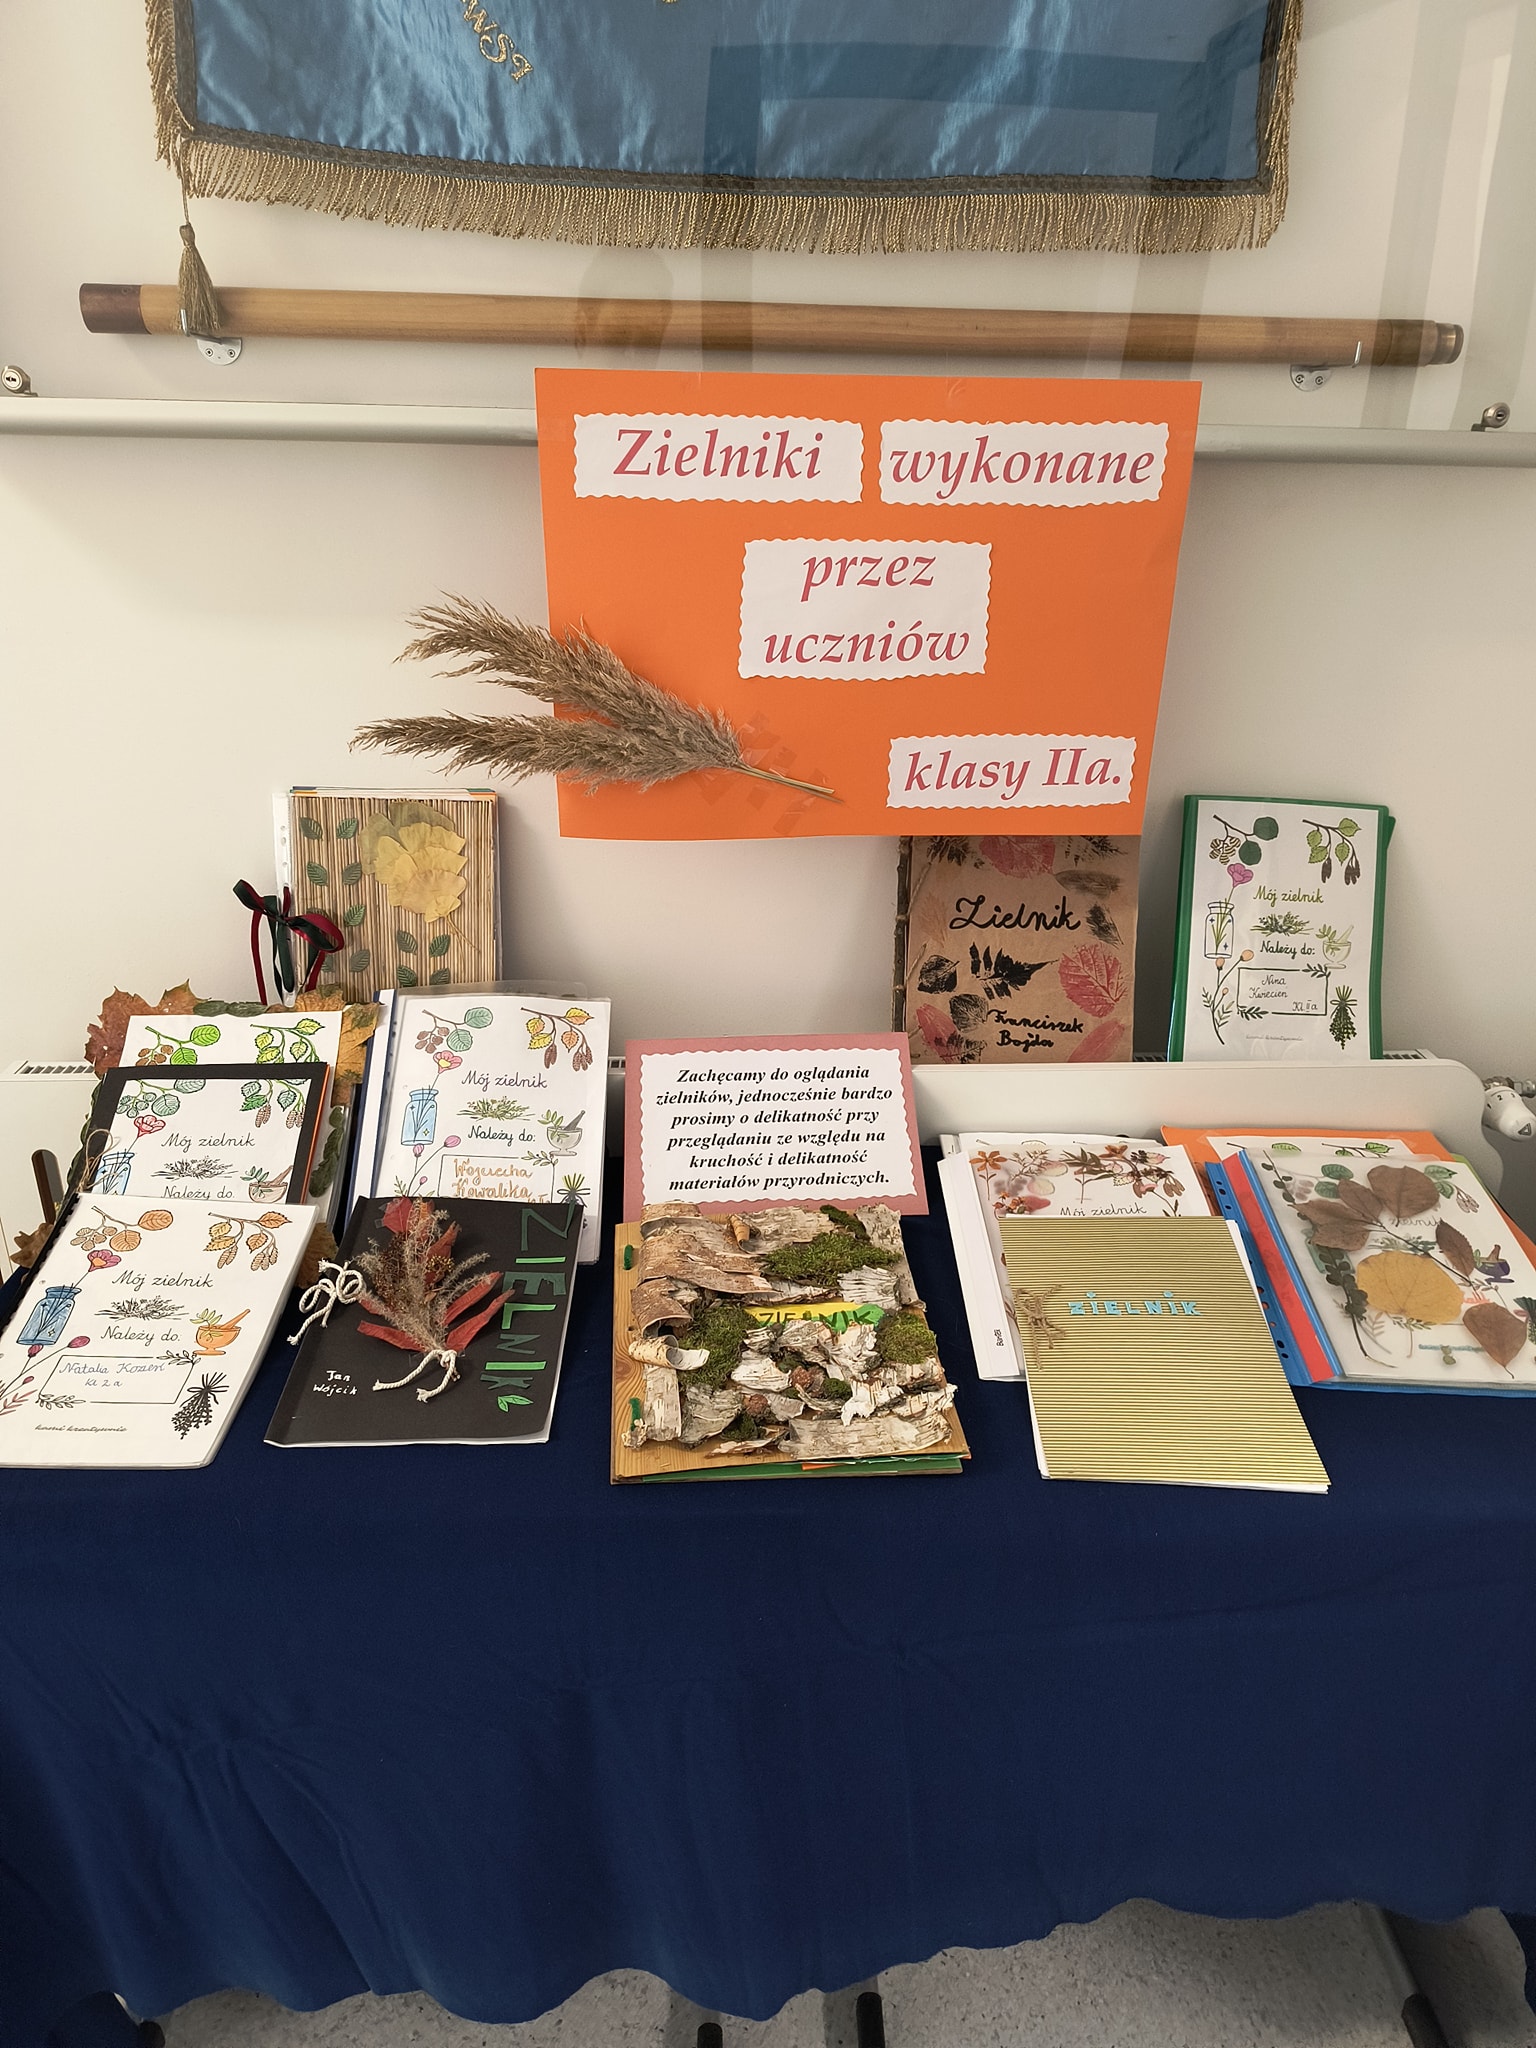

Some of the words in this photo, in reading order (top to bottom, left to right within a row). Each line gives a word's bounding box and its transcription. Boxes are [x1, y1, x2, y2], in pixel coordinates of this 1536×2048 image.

[613, 428, 824, 478] Zielniki
[890, 436, 1155, 500] wykonane
[801, 554, 937, 602] przez
[764, 620, 970, 664] uczniów
[904, 752, 1030, 800] klasy
[1041, 748, 1122, 787] IIa.
[1253, 886, 1276, 907] Mój
[1281, 889, 1324, 904] zielnik
[949, 895, 1081, 931] Zielnik
[1260, 940, 1297, 960] Należy
[1300, 942, 1316, 955] do:
[987, 1009, 1083, 1033] Franciszek
[997, 1030, 1054, 1053] Bojda
[461, 1071, 490, 1092] Mój
[494, 1073, 548, 1088] zielnik
[677, 1069, 766, 1084] Zachęcamy
[770, 1068, 788, 1081] do
[794, 1066, 870, 1083] oglądania
[656, 1091, 733, 1105] zielników,
[736, 1088, 836, 1106] jednocześnie
[842, 1087, 893, 1100] bardzo
[671, 1113, 735, 1129] prosimy
[740, 1114, 749, 1124] o
[754, 1108, 842, 1124] delikatność
[846, 1109, 880, 1125] przy
[161, 1133, 192, 1153] Mój
[198, 1135, 256, 1147] zielnik
[468, 1125, 513, 1147] Należy
[518, 1128, 536, 1142] do:
[667, 1134, 772, 1151] przeglądaniu
[777, 1134, 793, 1144] ze
[798, 1130, 860, 1146] względu
[866, 1131, 885, 1142] na
[689, 1154, 763, 1168] kruchość
[768, 1152, 773, 1165] i
[778, 1150, 868, 1165] delikatność
[669, 1175, 759, 1190] materiałów
[764, 1170, 890, 1190] przyrodniczych.
[161, 1185, 210, 1200] Należy
[1091, 1202, 1147, 1216] zielnik
[112, 1270, 145, 1292] Mój
[152, 1272, 213, 1288] zielnik
[480, 1199, 577, 1390] ZIELNIK
[100, 1325, 154, 1347] Należy
[59, 1363, 109, 1374] Natalia
[326, 1370, 351, 1381] Jan
[313, 1384, 358, 1396] Wójcik
